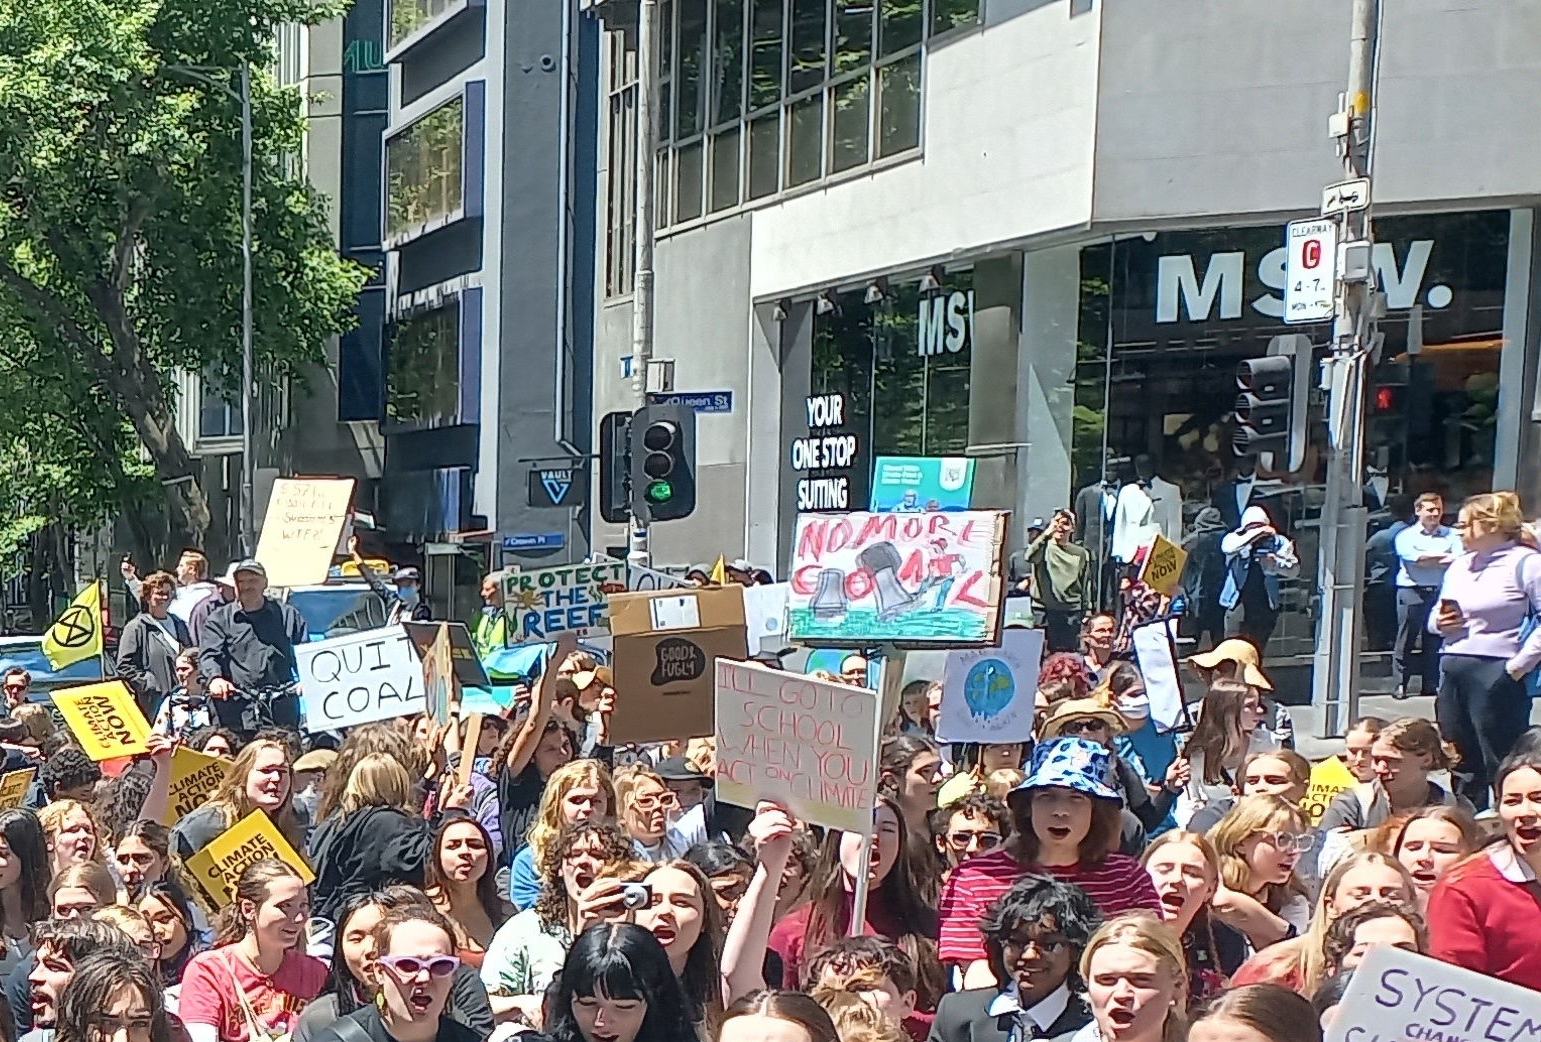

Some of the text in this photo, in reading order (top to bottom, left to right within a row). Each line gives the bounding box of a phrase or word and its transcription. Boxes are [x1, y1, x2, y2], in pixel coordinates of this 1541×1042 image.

[1292, 225, 1332, 237] CLEARWAY
[805, 395, 843, 427] YOUR
[792, 436, 856, 471] ONE STOP
[541, 470, 573, 480] VAULT
[797, 478, 848, 511] SUITING
[507, 563, 625, 595] PROTECT
[542, 586, 590, 608] THE
[523, 603, 609, 640] REEF
[311, 635, 414, 684] QUIT
[661, 660, 696, 678] FUGLY
[323, 676, 426, 720] COAL
[779, 679, 817, 710] GO
[93, 694, 136, 746] NOW
[740, 701, 852, 751] SCHOOL
[717, 725, 868, 786] WHEN YOU
[168, 762, 222, 797] CLIMATE
[178, 770, 226, 802] ACTION
[717, 758, 869, 810] ACT ON CLIMATE
[207, 832, 266, 880] CLIMATE
